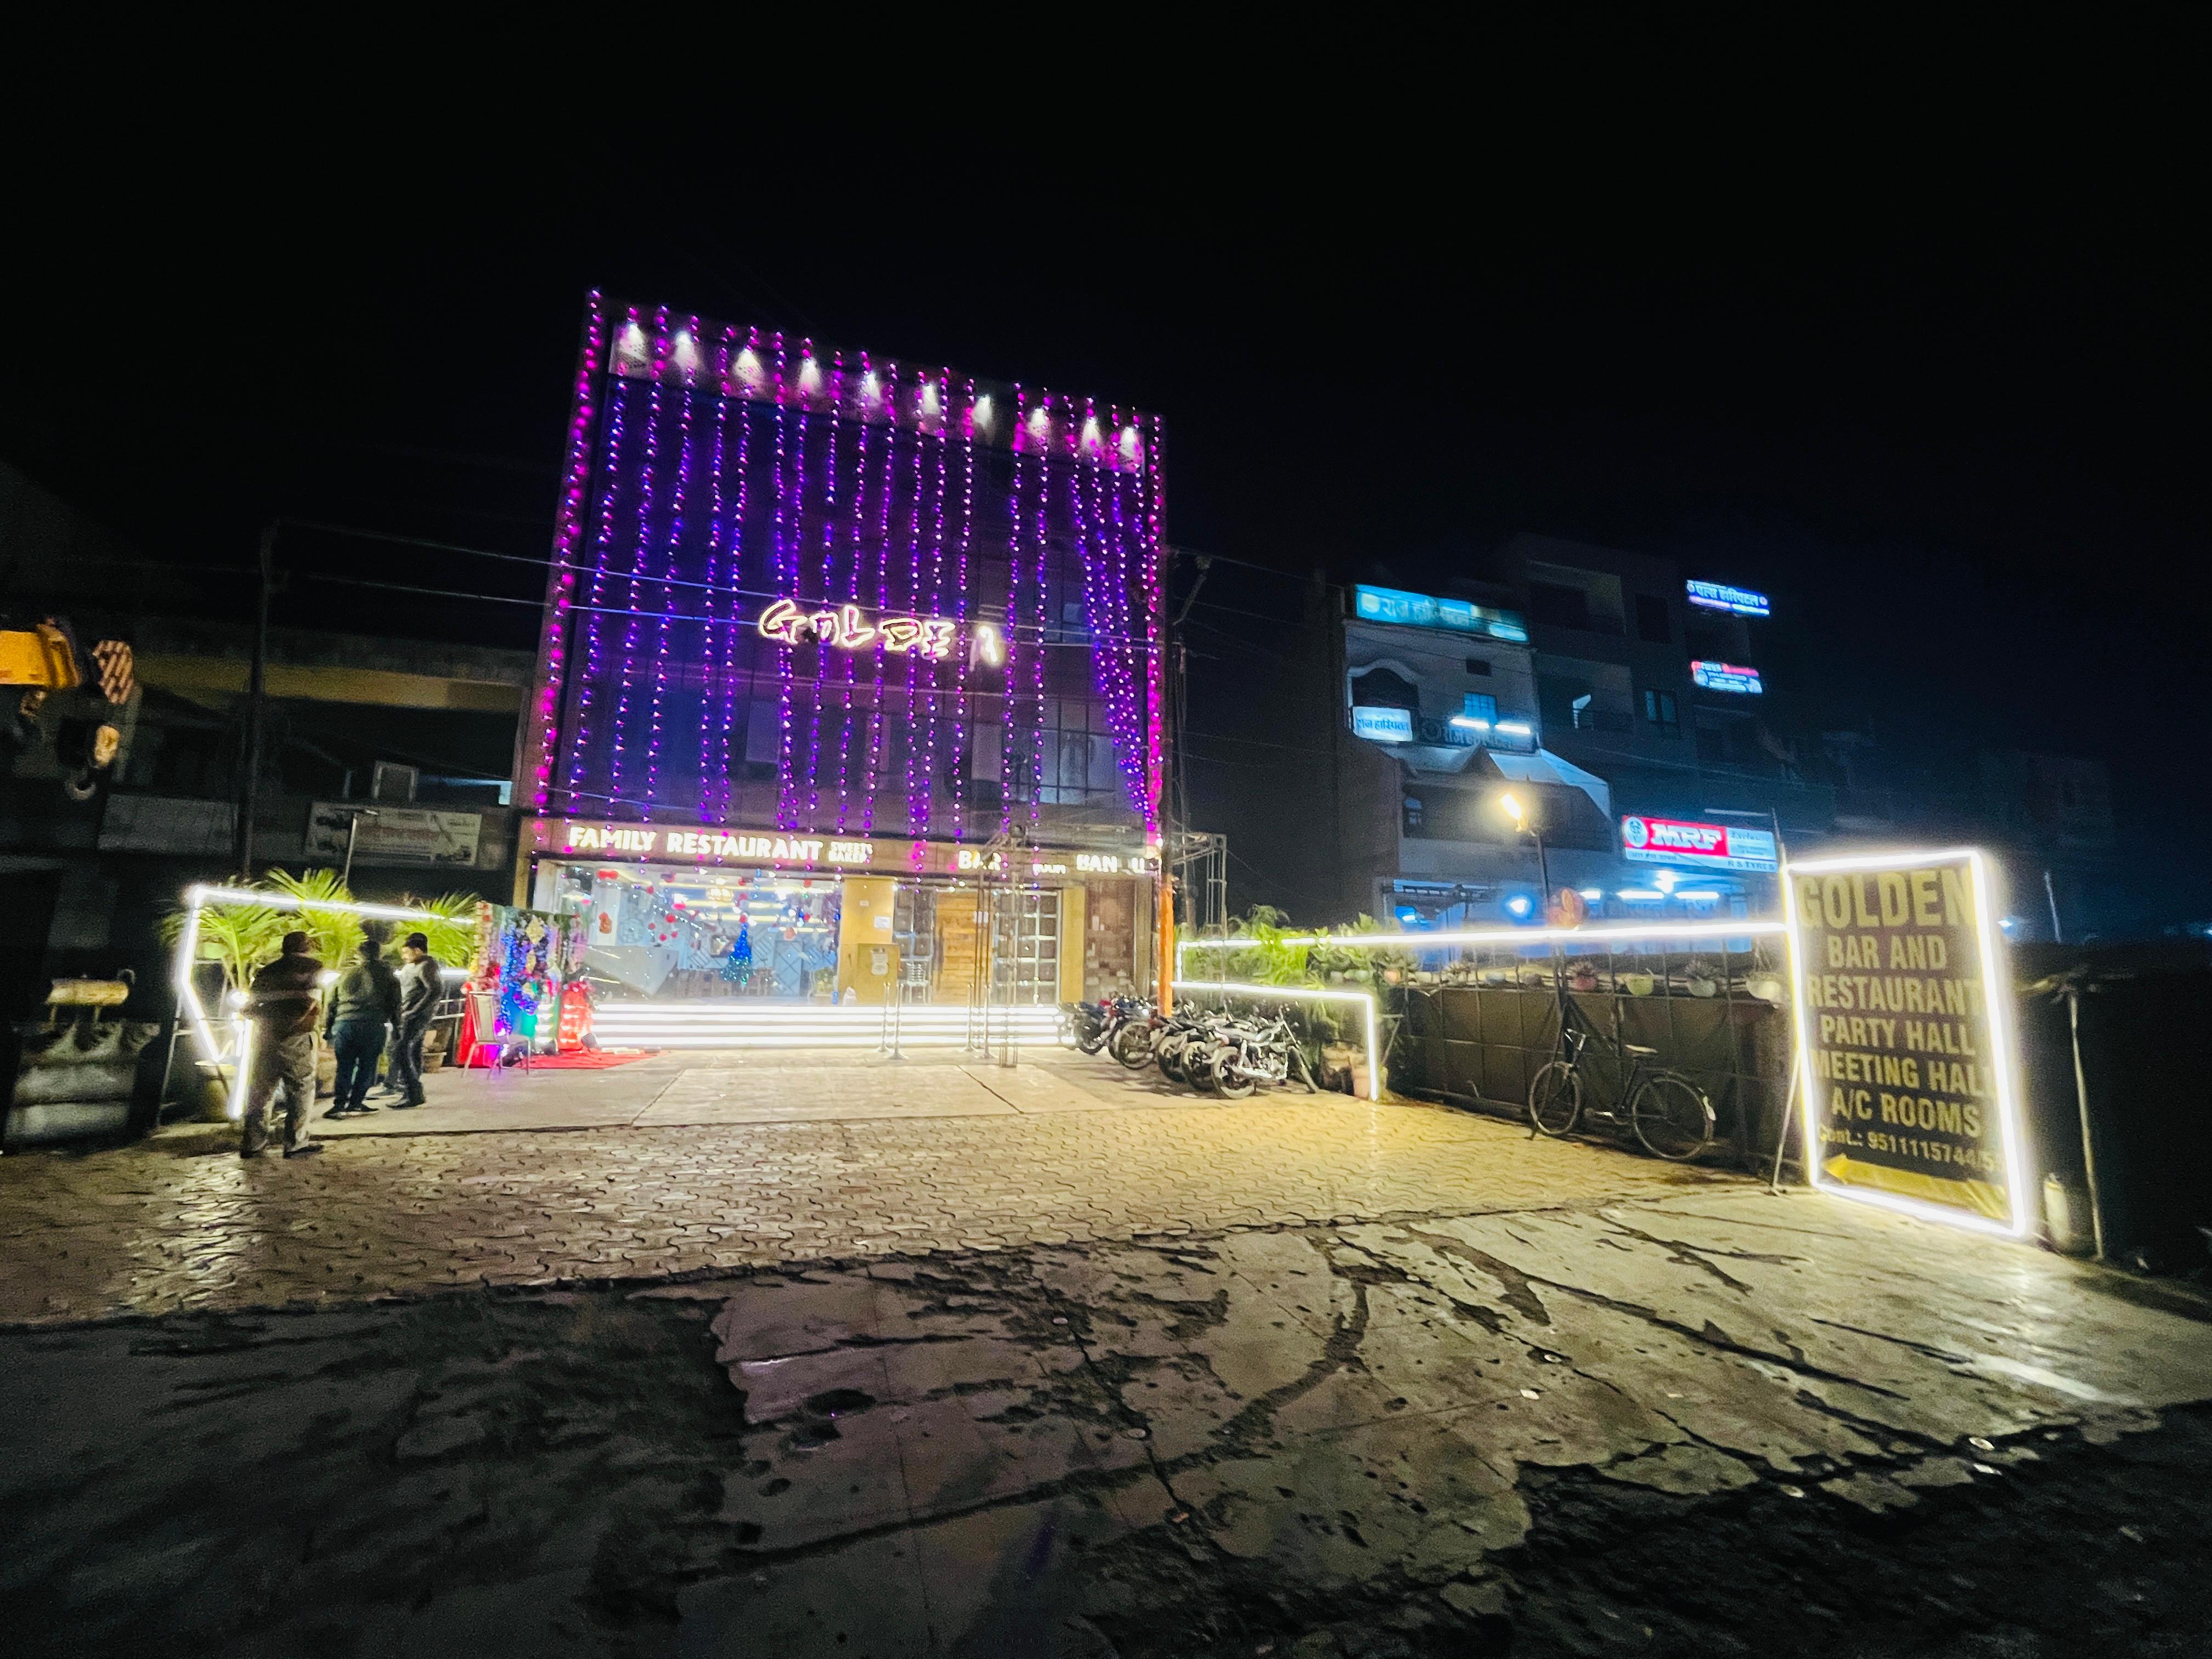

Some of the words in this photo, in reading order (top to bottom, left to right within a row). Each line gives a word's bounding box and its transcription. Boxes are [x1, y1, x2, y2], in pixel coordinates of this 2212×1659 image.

[568, 826, 657, 851] FAMILY
[666, 831, 823, 861] RESTAURANT
[1650, 823, 1723, 850] MRF
[1796, 868, 1977, 928] GOLDEN
[1826, 934, 1881, 969] BAR
[1890, 934, 1947, 970] AND
[1807, 974, 1985, 1015] RESTAURANT
[1820, 1014, 1896, 1049] PARTY
[1905, 1019, 1976, 1056] HALL
[1810, 1048, 1920, 1089] MEETING
[1832, 1086, 1873, 1120] A/C
[1880, 1092, 1982, 1138] ROOMS
